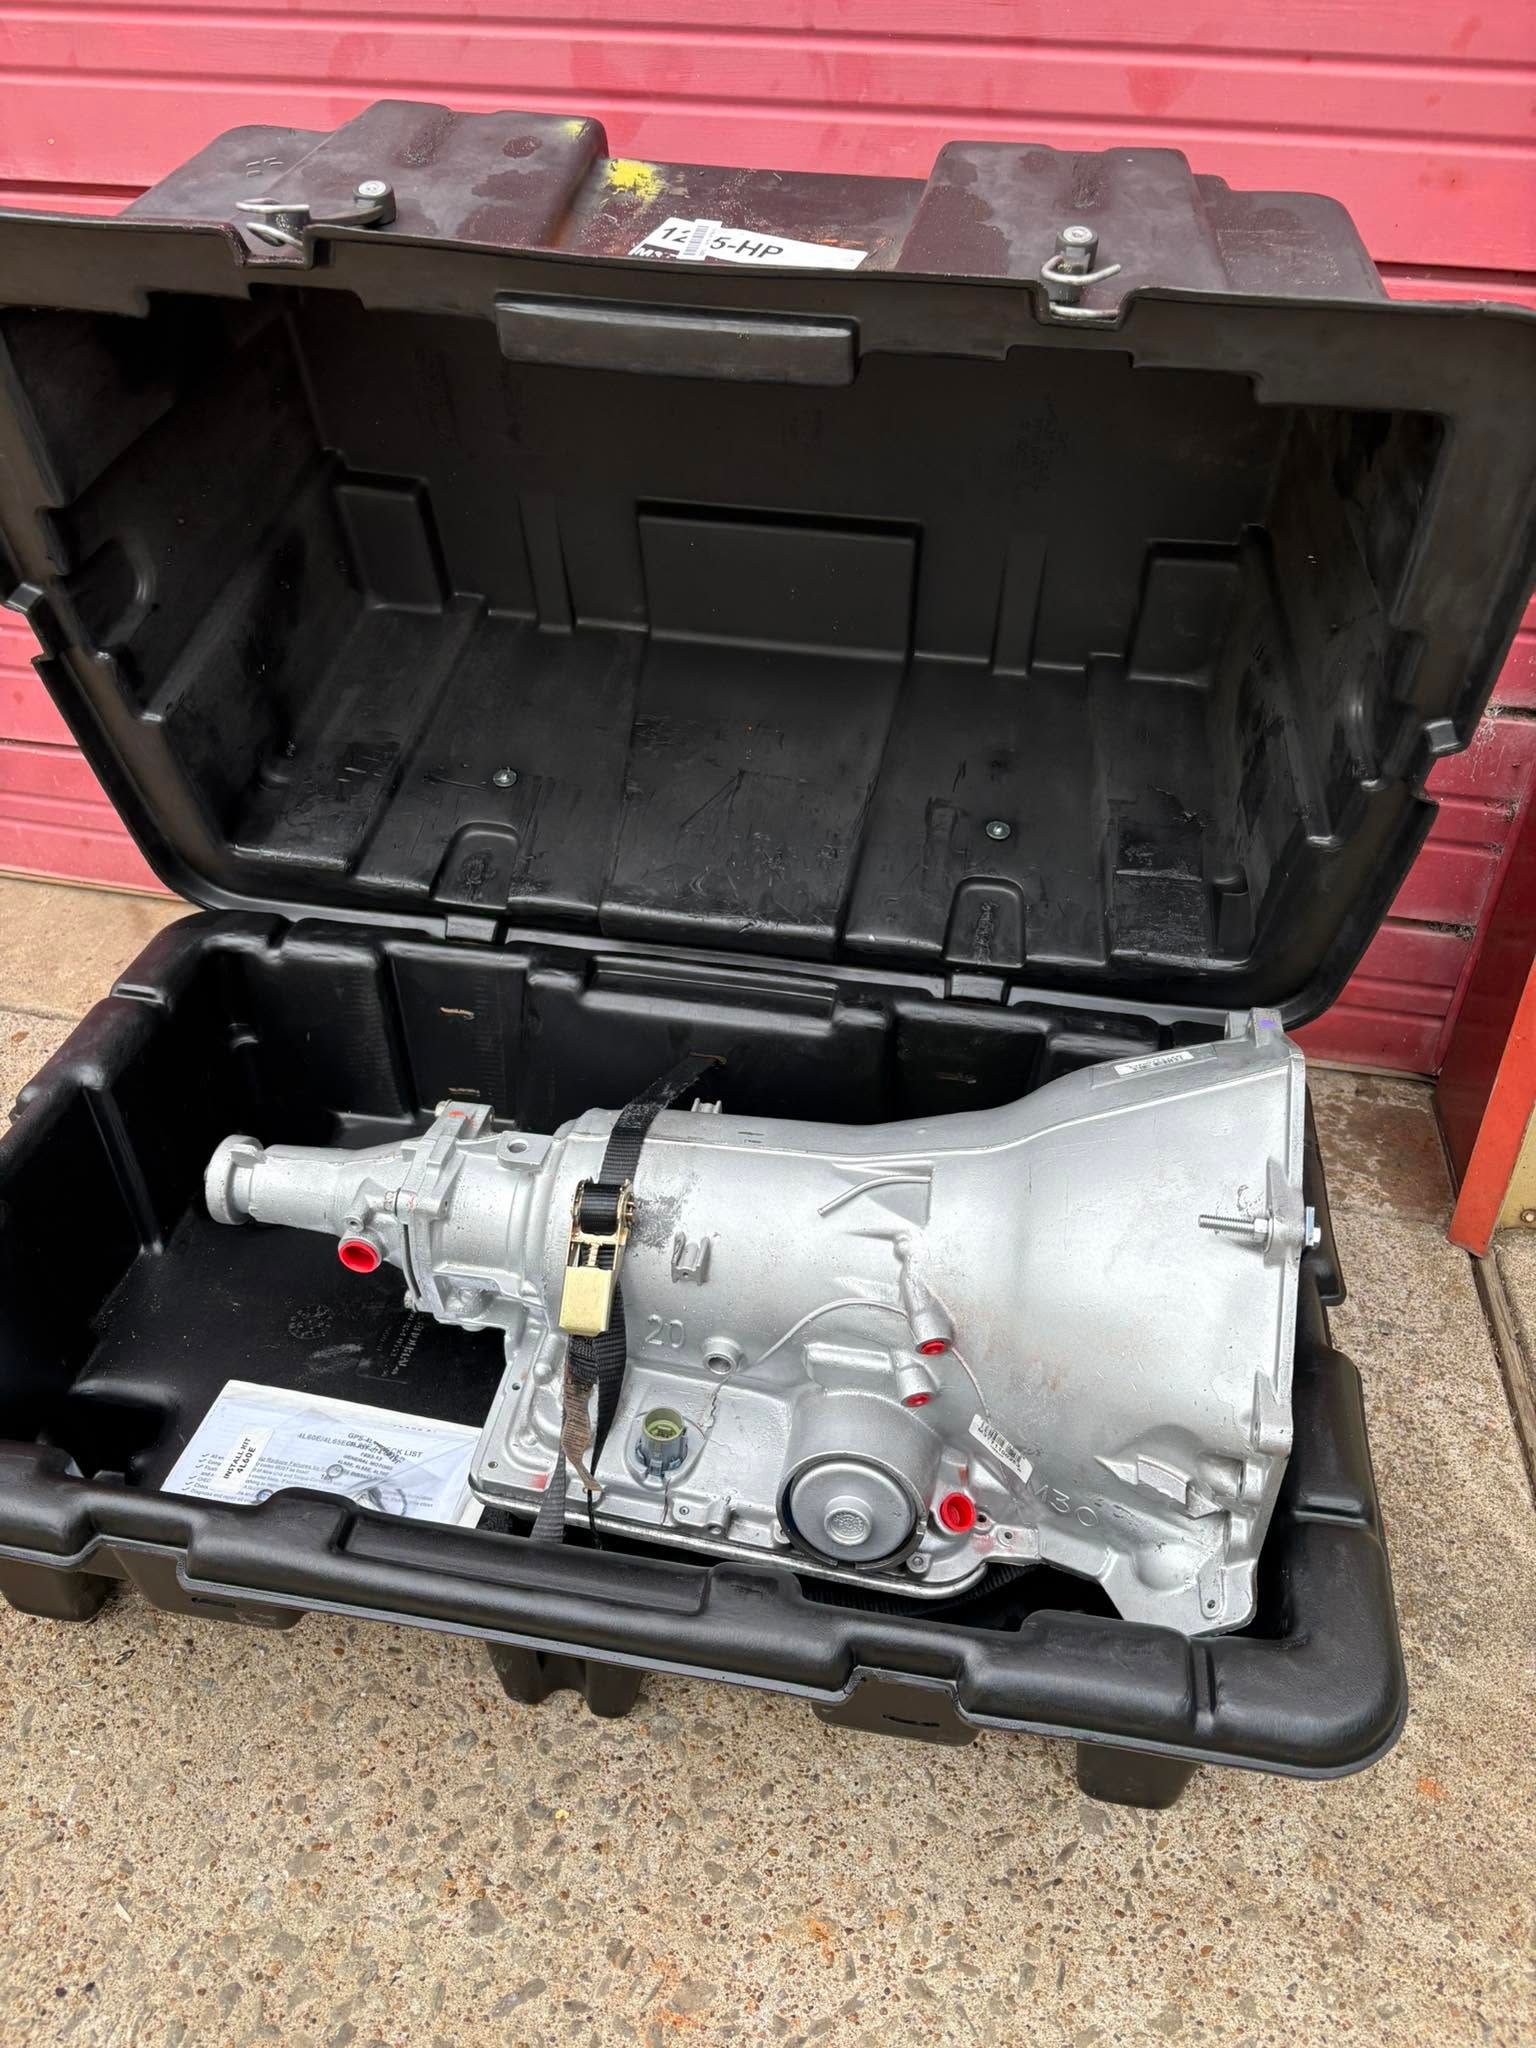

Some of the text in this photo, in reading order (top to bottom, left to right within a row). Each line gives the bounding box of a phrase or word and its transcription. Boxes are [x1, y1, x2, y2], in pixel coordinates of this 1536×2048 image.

[645, 1313, 686, 1349] 20
[223, 1437, 251, 1480] INSTALL KIT
[236, 1447, 257, 1475] 4L60E
